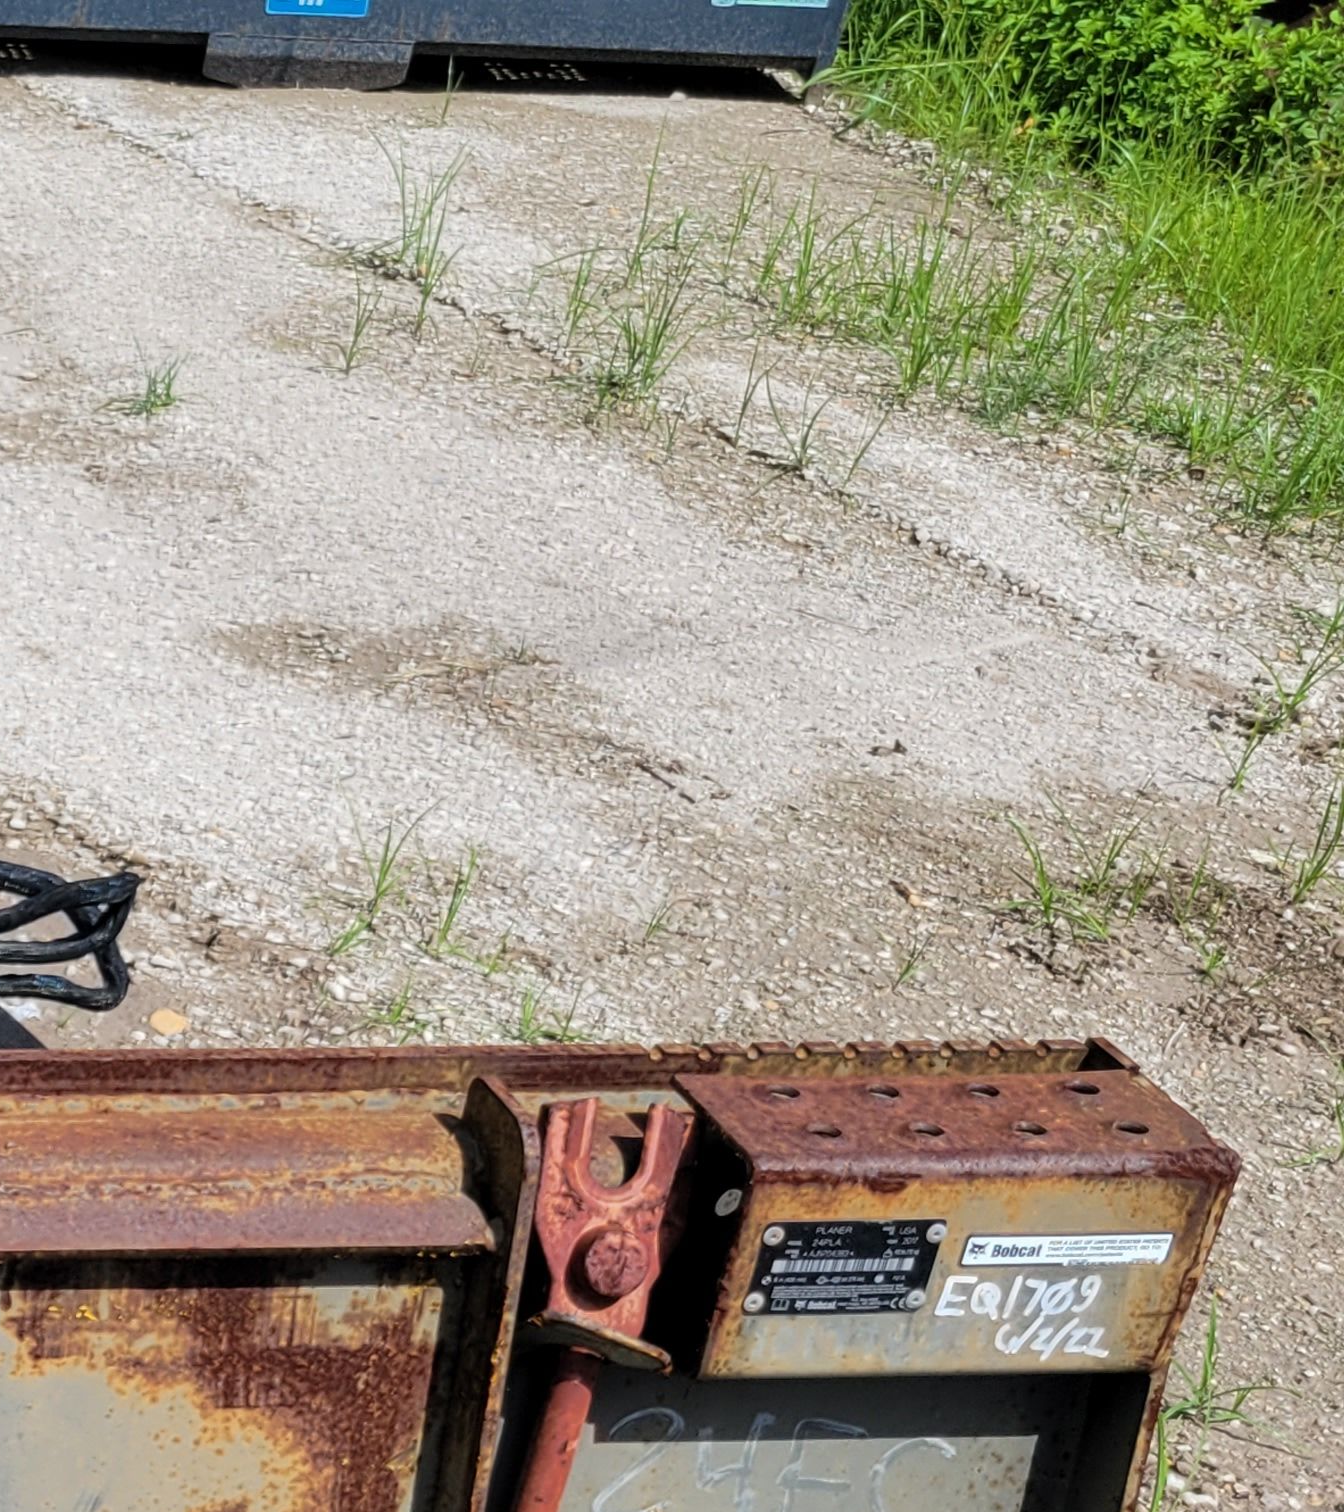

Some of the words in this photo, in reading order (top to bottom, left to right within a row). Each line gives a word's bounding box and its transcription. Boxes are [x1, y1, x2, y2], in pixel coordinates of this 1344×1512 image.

[815, 1226, 853, 1235] PLANER
[899, 1227, 917, 1236] USA
[991, 1243, 1043, 1259] Bobcat
